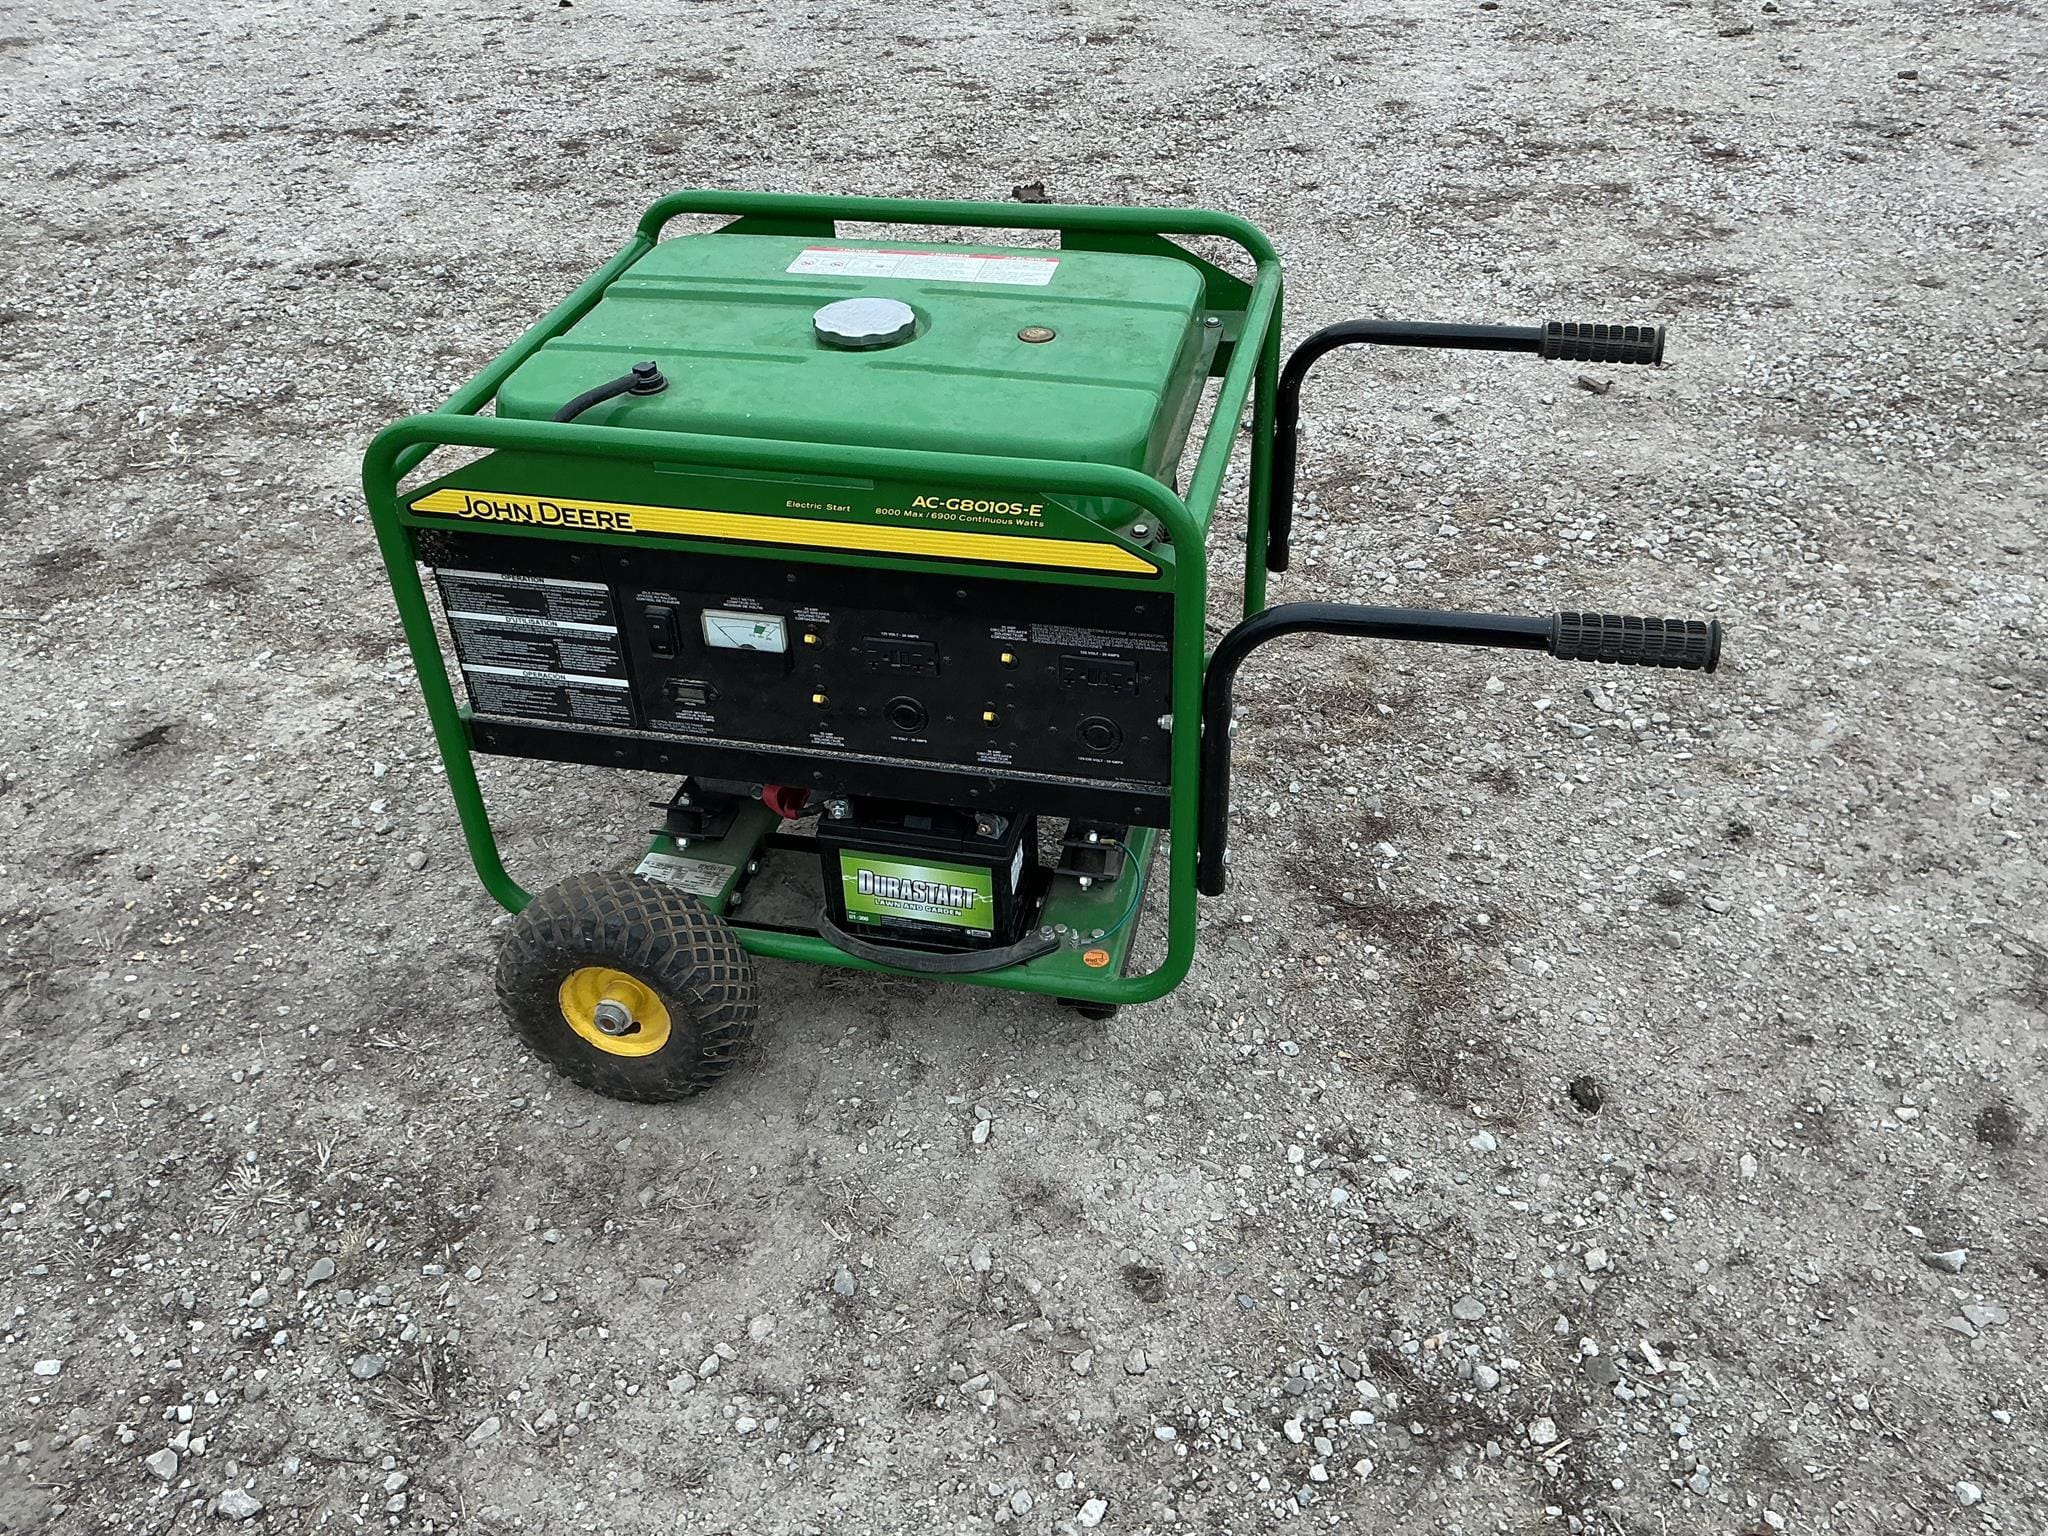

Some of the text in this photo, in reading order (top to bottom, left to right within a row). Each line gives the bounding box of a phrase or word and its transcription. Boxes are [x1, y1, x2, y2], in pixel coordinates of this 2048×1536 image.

[458, 495, 634, 530] JOHN DEERE
[786, 500, 851, 512] Electric Start
[911, 495, 1044, 517] AC-G8010S-E
[875, 507, 901, 517] 8000
[903, 508, 923, 518] Max
[931, 512, 957, 521] 6900
[958, 514, 1013, 525] Continuous
[1015, 518, 1045, 528] Watts
[501, 574, 545, 583] OPERATION
[505, 616, 558, 627] D'UTILISATION
[857, 868, 978, 910] DURASTART
[875, 899, 963, 917] LAWN AND GARDEN
